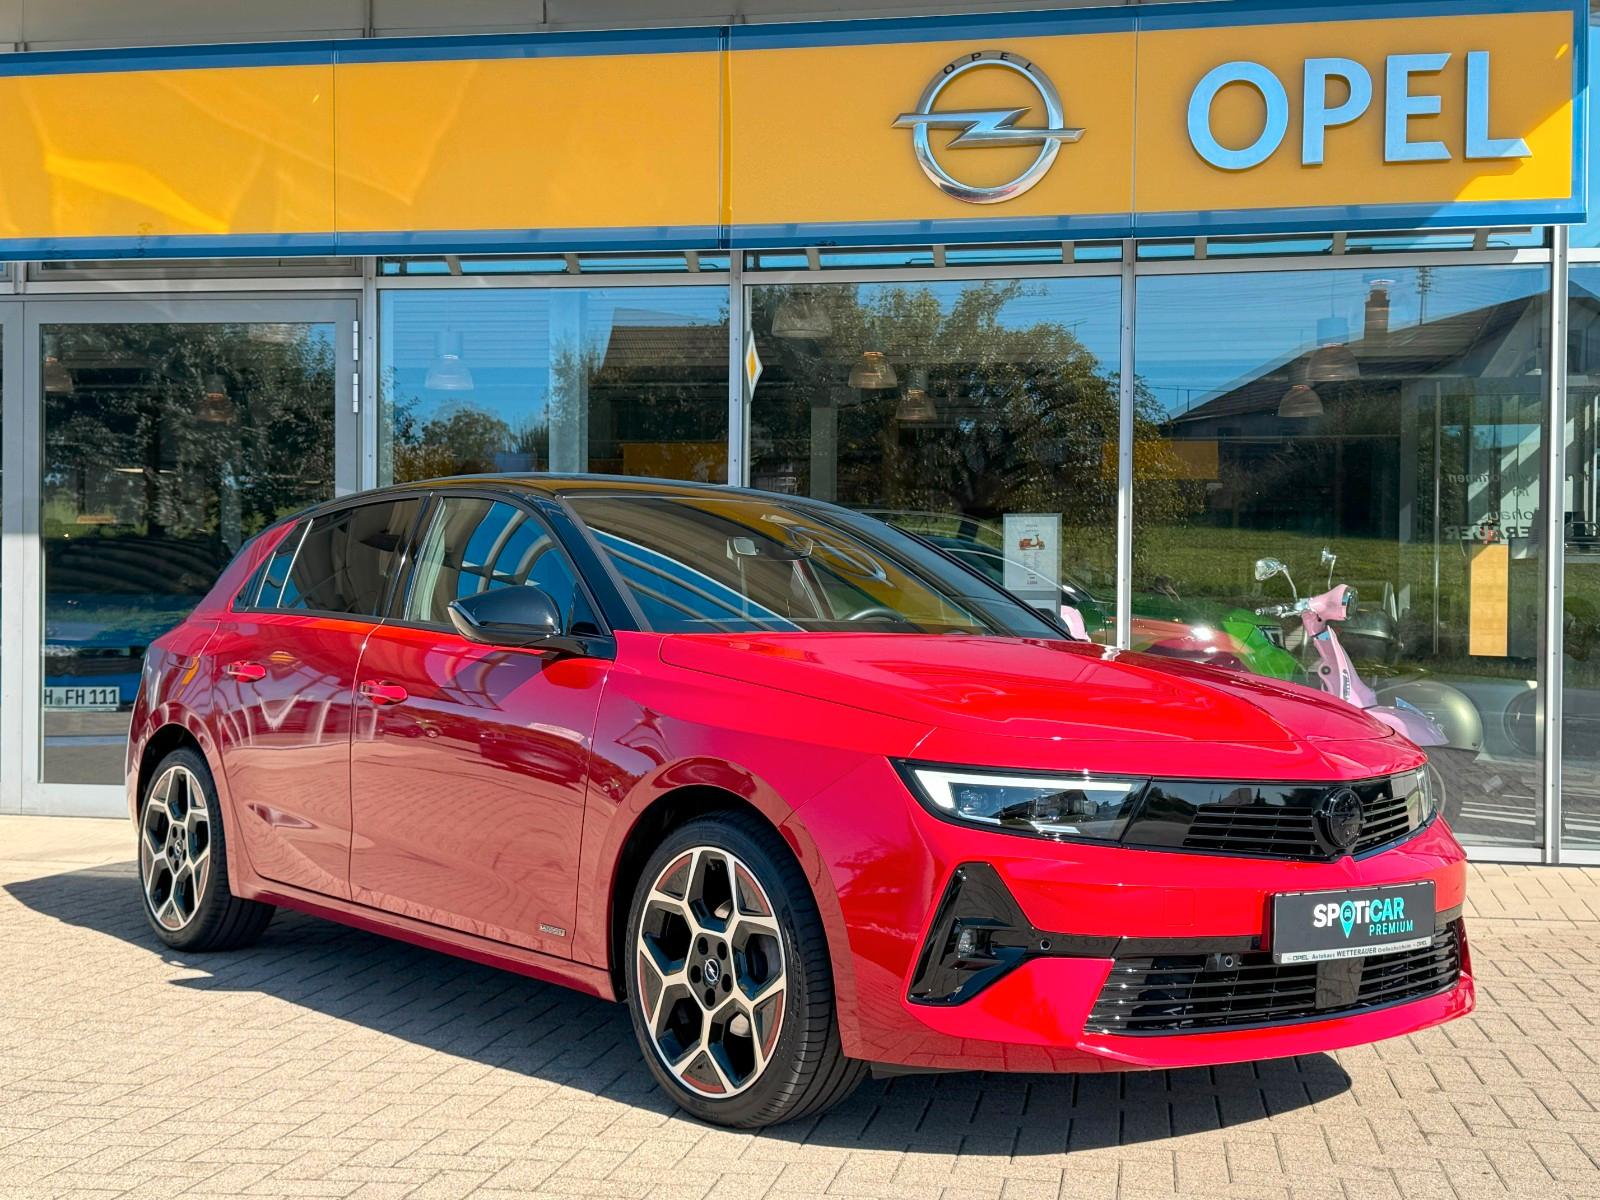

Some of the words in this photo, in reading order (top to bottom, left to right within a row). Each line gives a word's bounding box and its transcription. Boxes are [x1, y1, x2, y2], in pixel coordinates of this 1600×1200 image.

[943, 52, 1034, 74] OPEL
[1187, 50, 1533, 170] OPEL
[65, 689, 85, 704] FH
[88, 689, 118, 704] 111
[1369, 920, 1414, 936] PREMIUM
[1336, 946, 1377, 957] WETTERAUER
